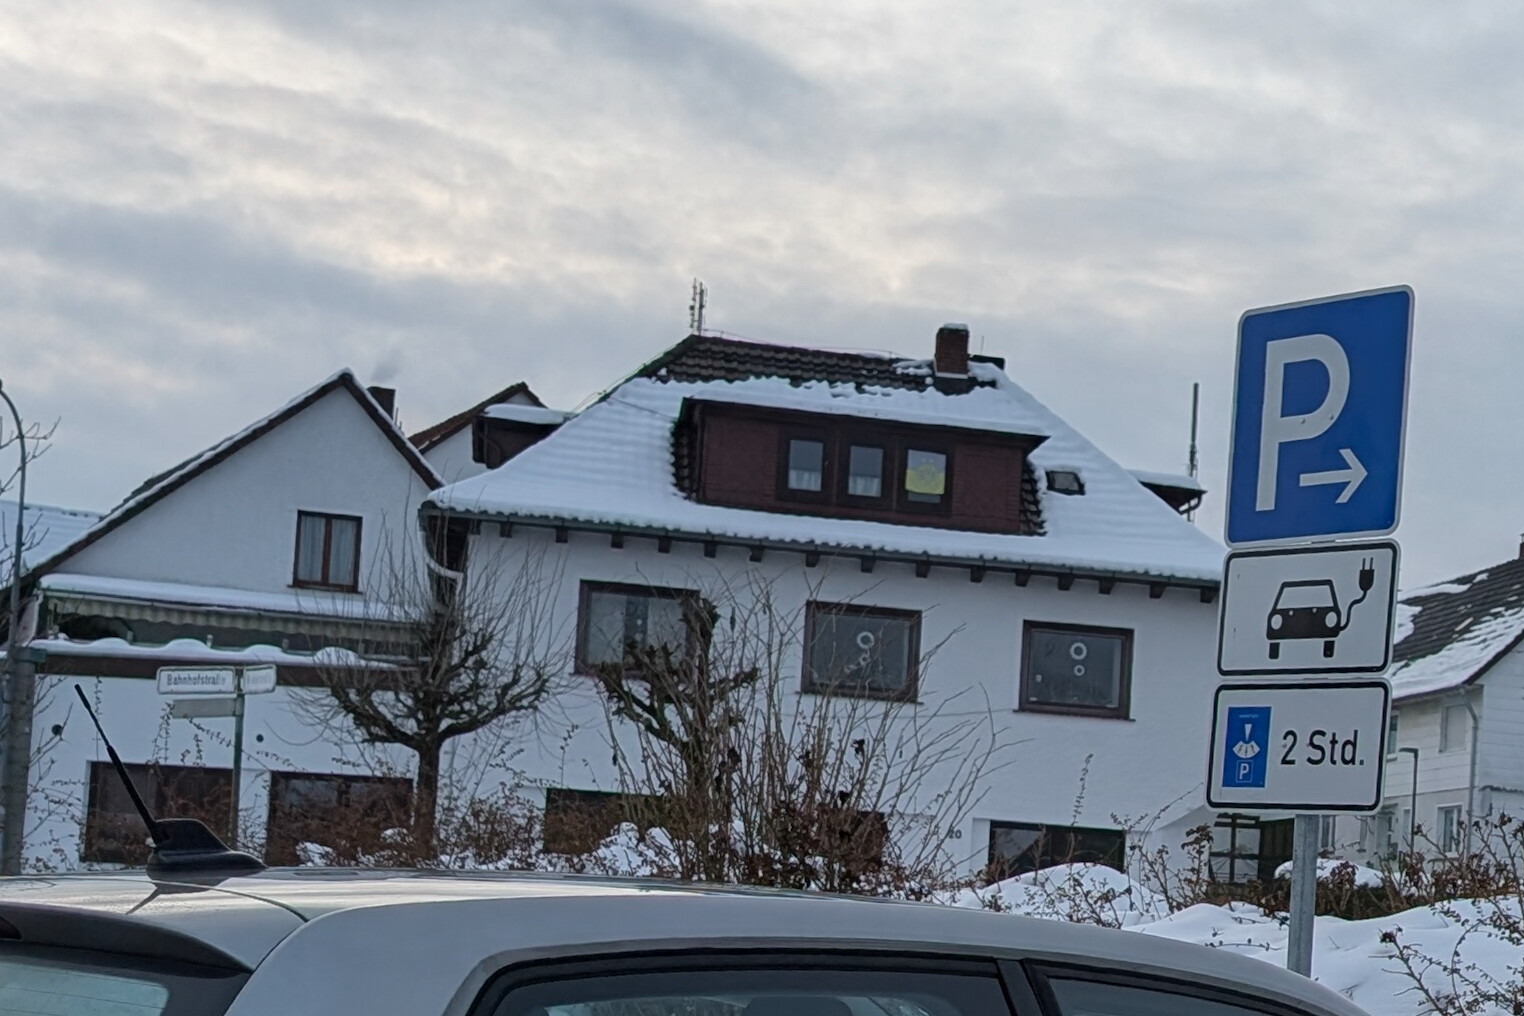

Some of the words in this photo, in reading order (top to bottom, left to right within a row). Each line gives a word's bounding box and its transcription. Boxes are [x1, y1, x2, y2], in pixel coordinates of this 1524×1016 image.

[1255, 333, 1351, 512] P
[1281, 729, 1297, 765] 2
[1306, 729, 1365, 766] Std.
[1239, 762, 1250, 780] P
